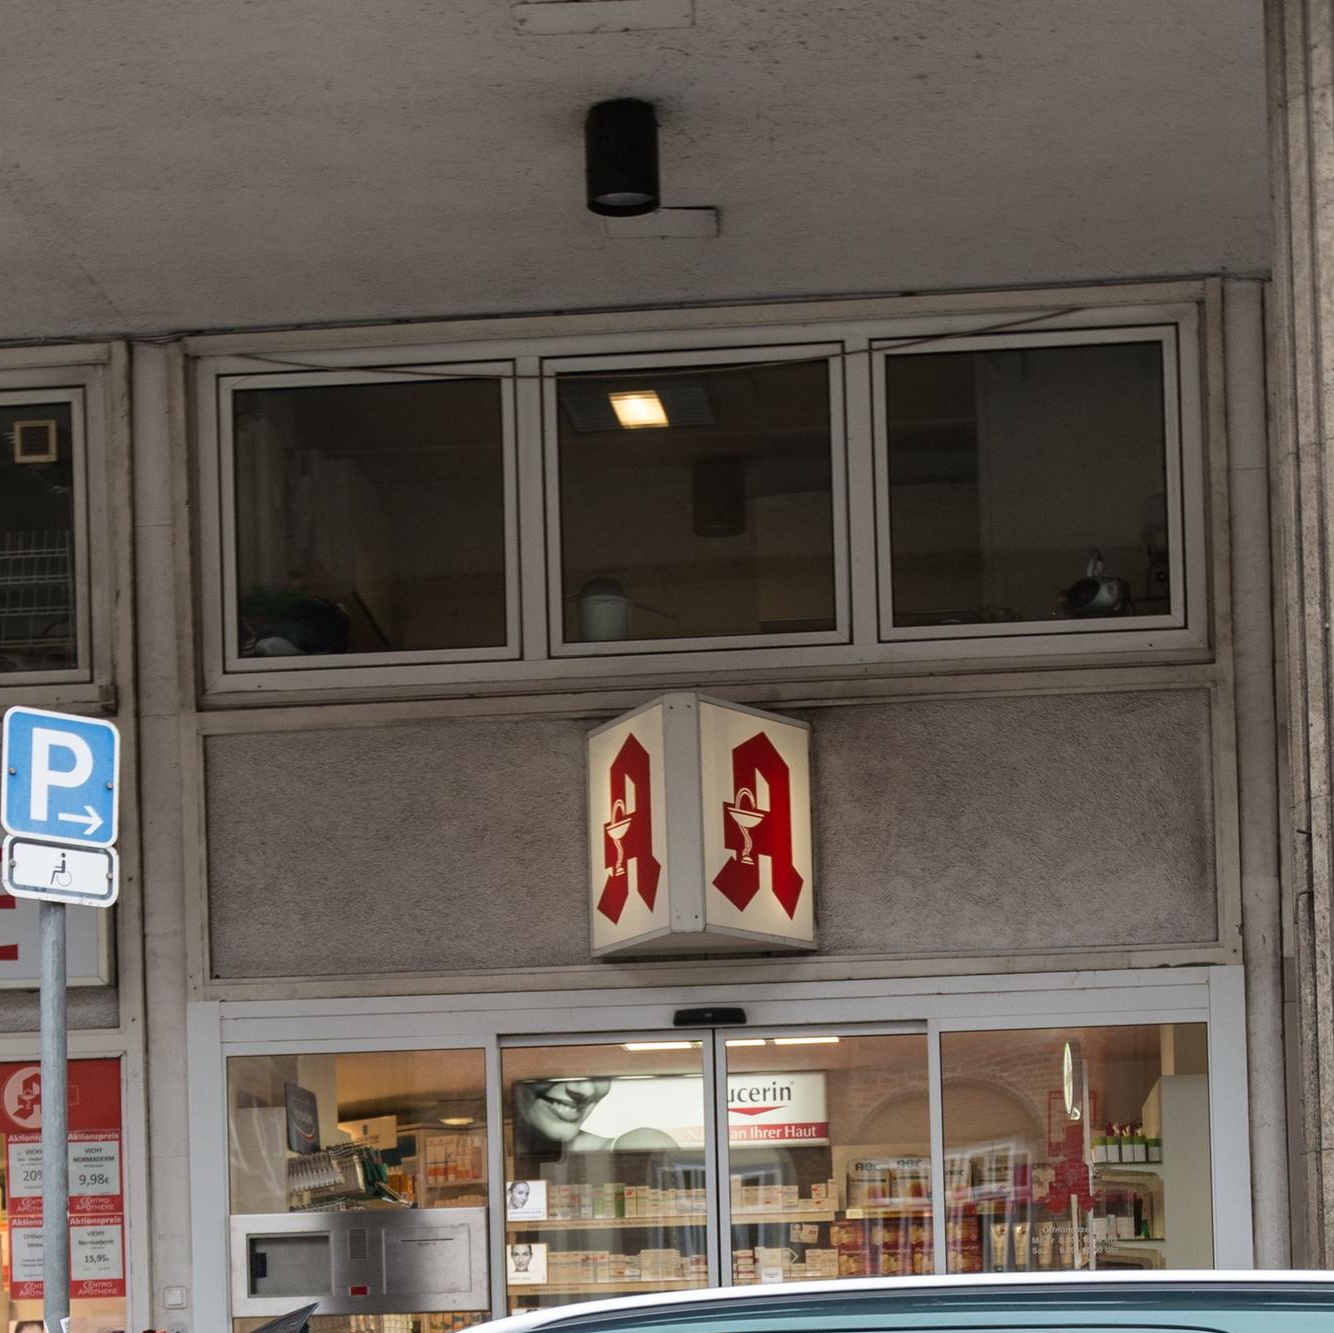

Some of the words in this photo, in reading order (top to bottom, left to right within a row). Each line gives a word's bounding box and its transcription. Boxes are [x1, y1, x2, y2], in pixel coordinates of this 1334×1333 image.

[29, 727, 93, 822] P
[728, 1082, 792, 1103] ucerin
[68, 1131, 119, 1141] Aktionspreis
[730, 1128, 747, 1139] an
[751, 1126, 782, 1139] Ihrer
[784, 1125, 817, 1138] Haut
[69, 1216, 122, 1226] Aktionspreis
